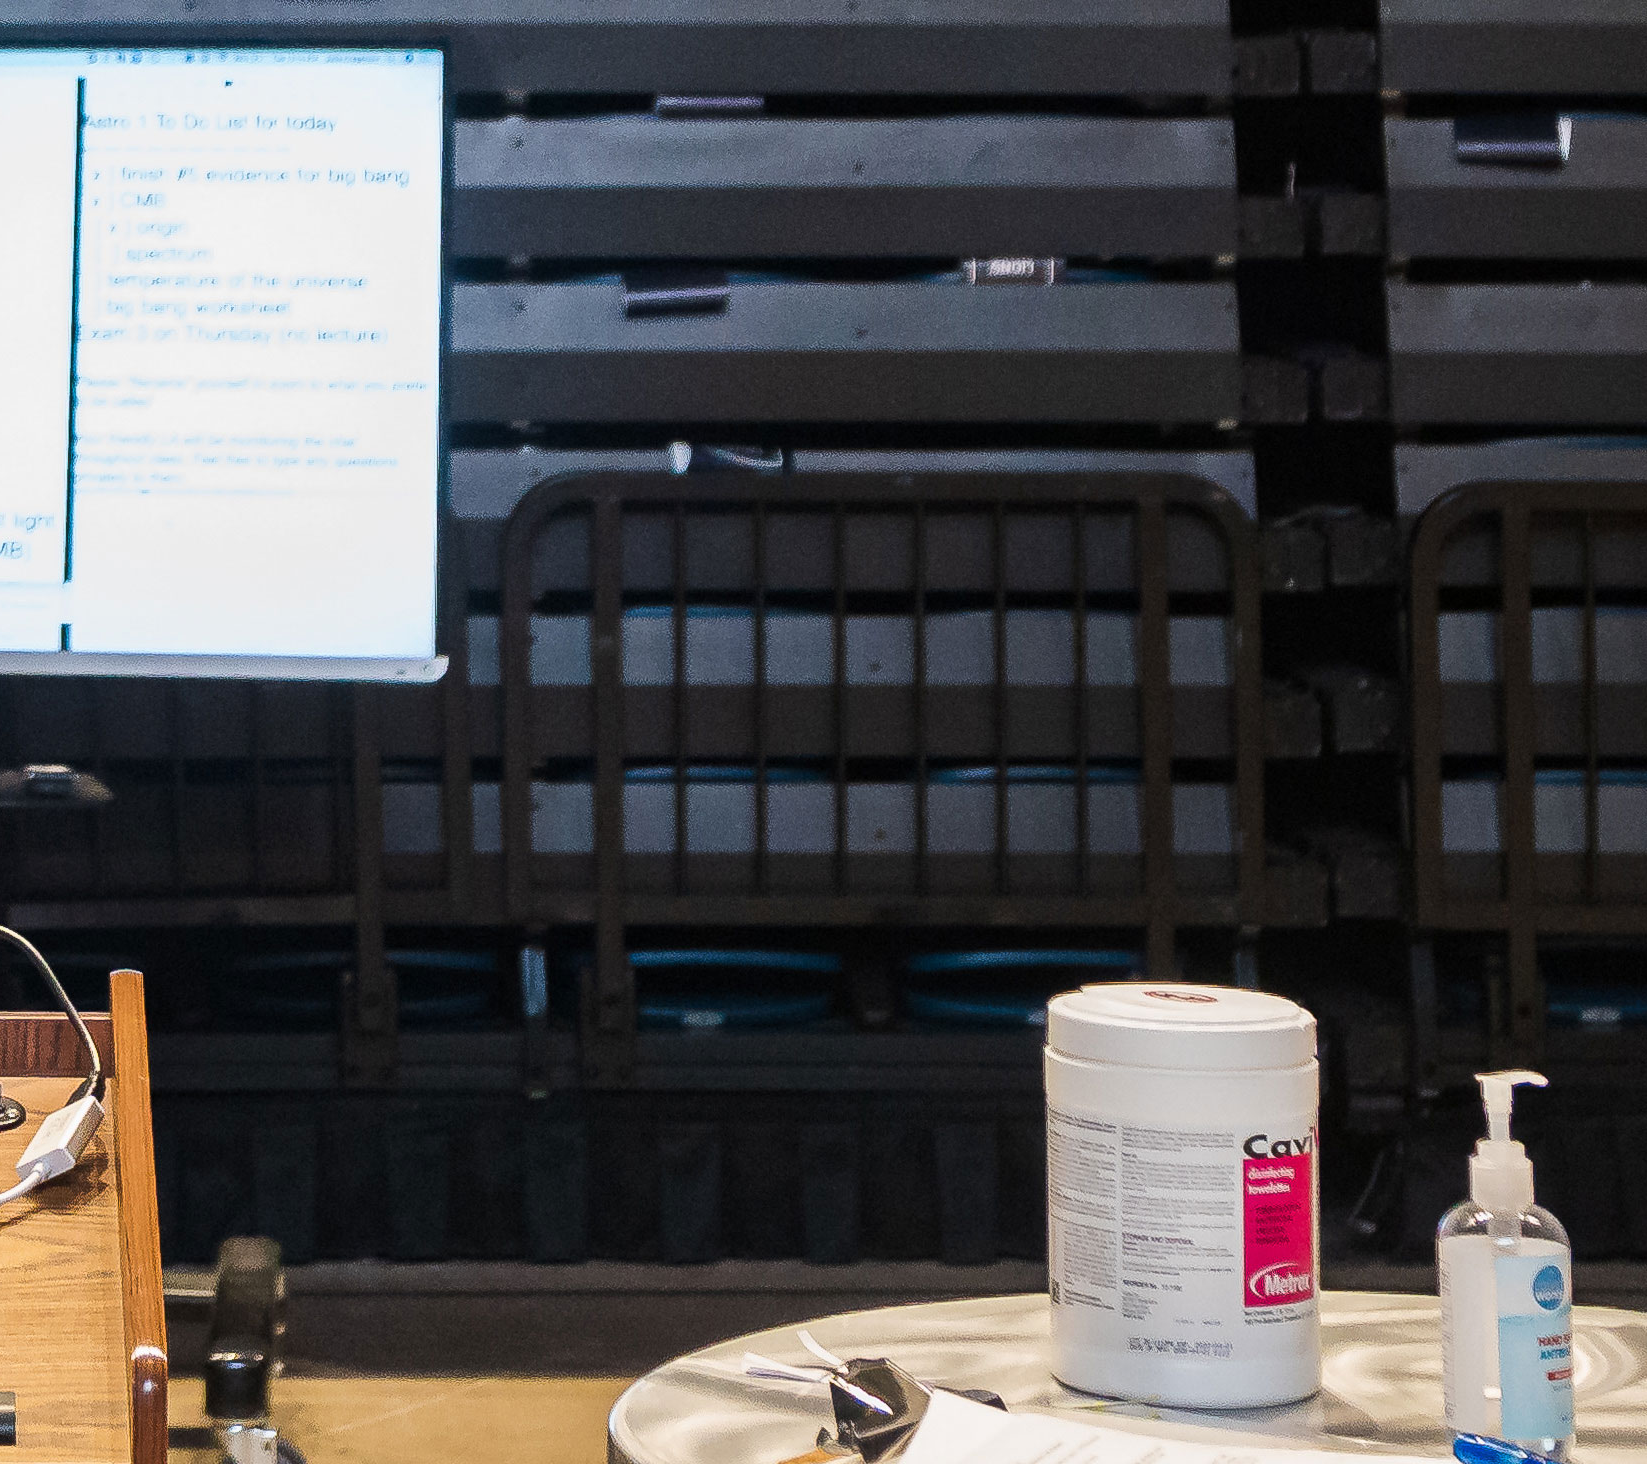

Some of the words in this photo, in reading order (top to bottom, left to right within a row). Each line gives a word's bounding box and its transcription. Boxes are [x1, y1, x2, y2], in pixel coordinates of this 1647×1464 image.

[285, 114, 338, 134] today
[327, 167, 357, 188] big
[362, 167, 412, 189] bang
